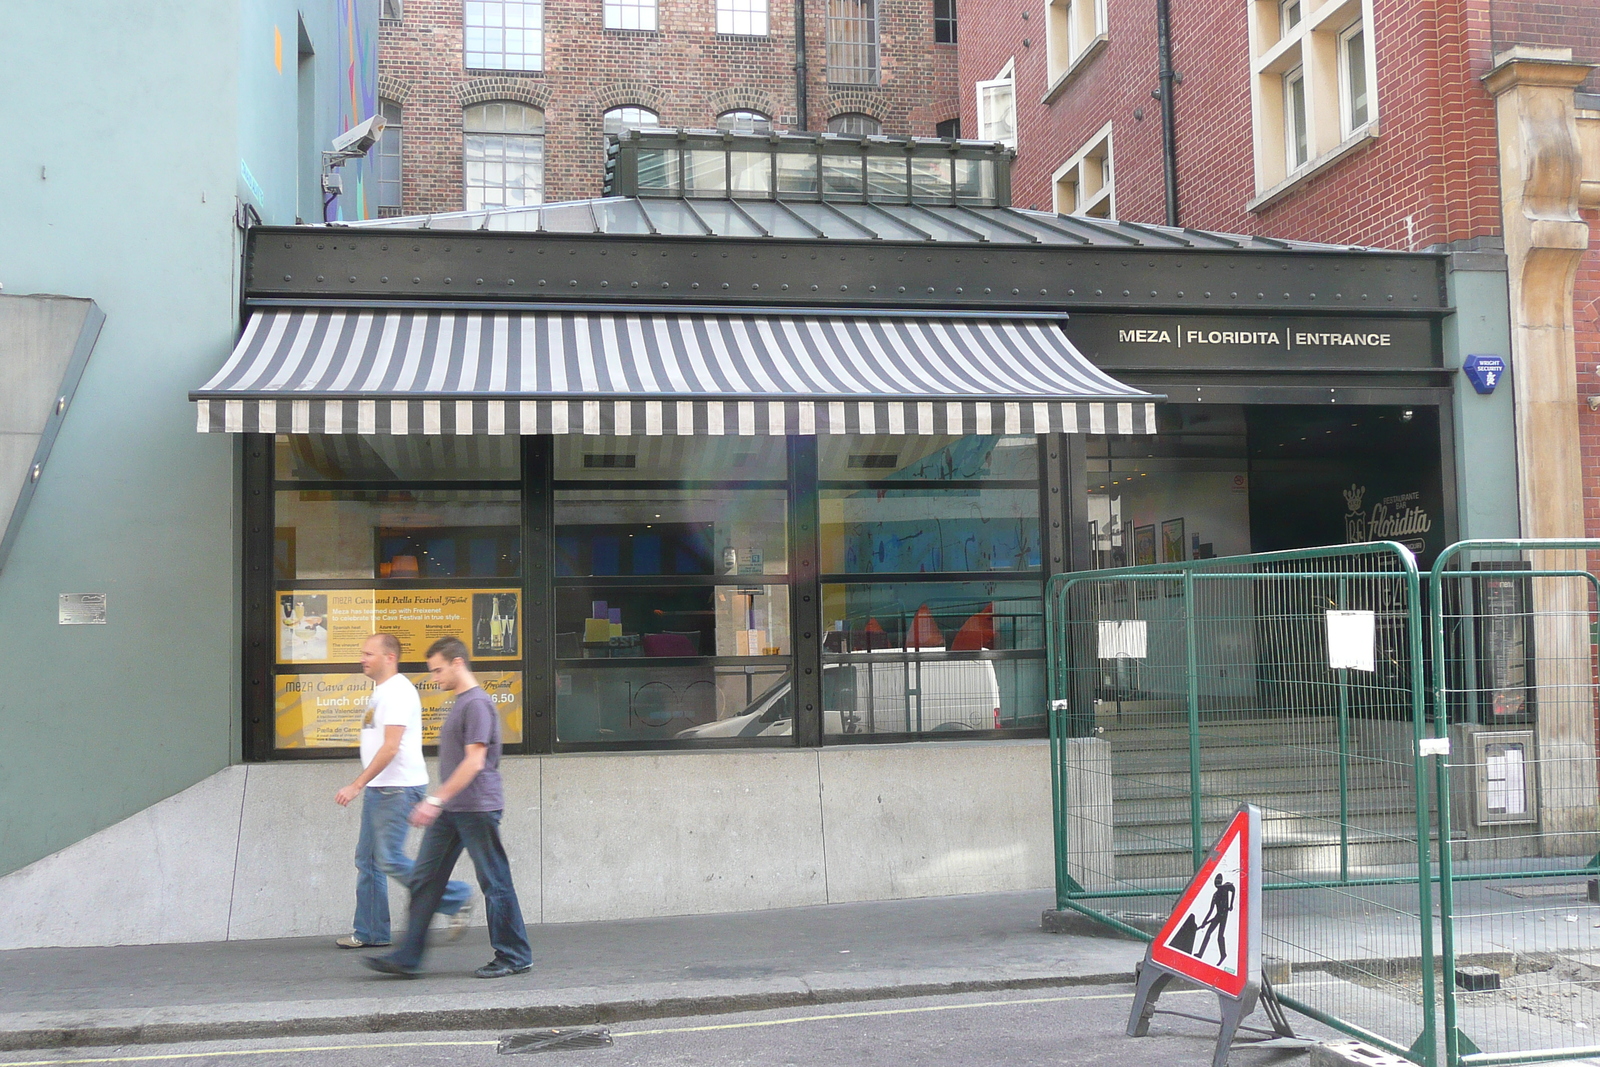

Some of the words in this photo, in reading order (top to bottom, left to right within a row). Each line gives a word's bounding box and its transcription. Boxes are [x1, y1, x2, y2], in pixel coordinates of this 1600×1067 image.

[1118, 329, 1171, 343] MEZA
[1187, 330, 1280, 345] FLORIDITA
[1295, 332, 1391, 346] ENTRANCE
[375, 596, 391, 605] and
[414, 595, 442, 604] Festival
[316, 681, 344, 692] Cava
[346, 680, 367, 691] and
[316, 696, 350, 706] Lunch
